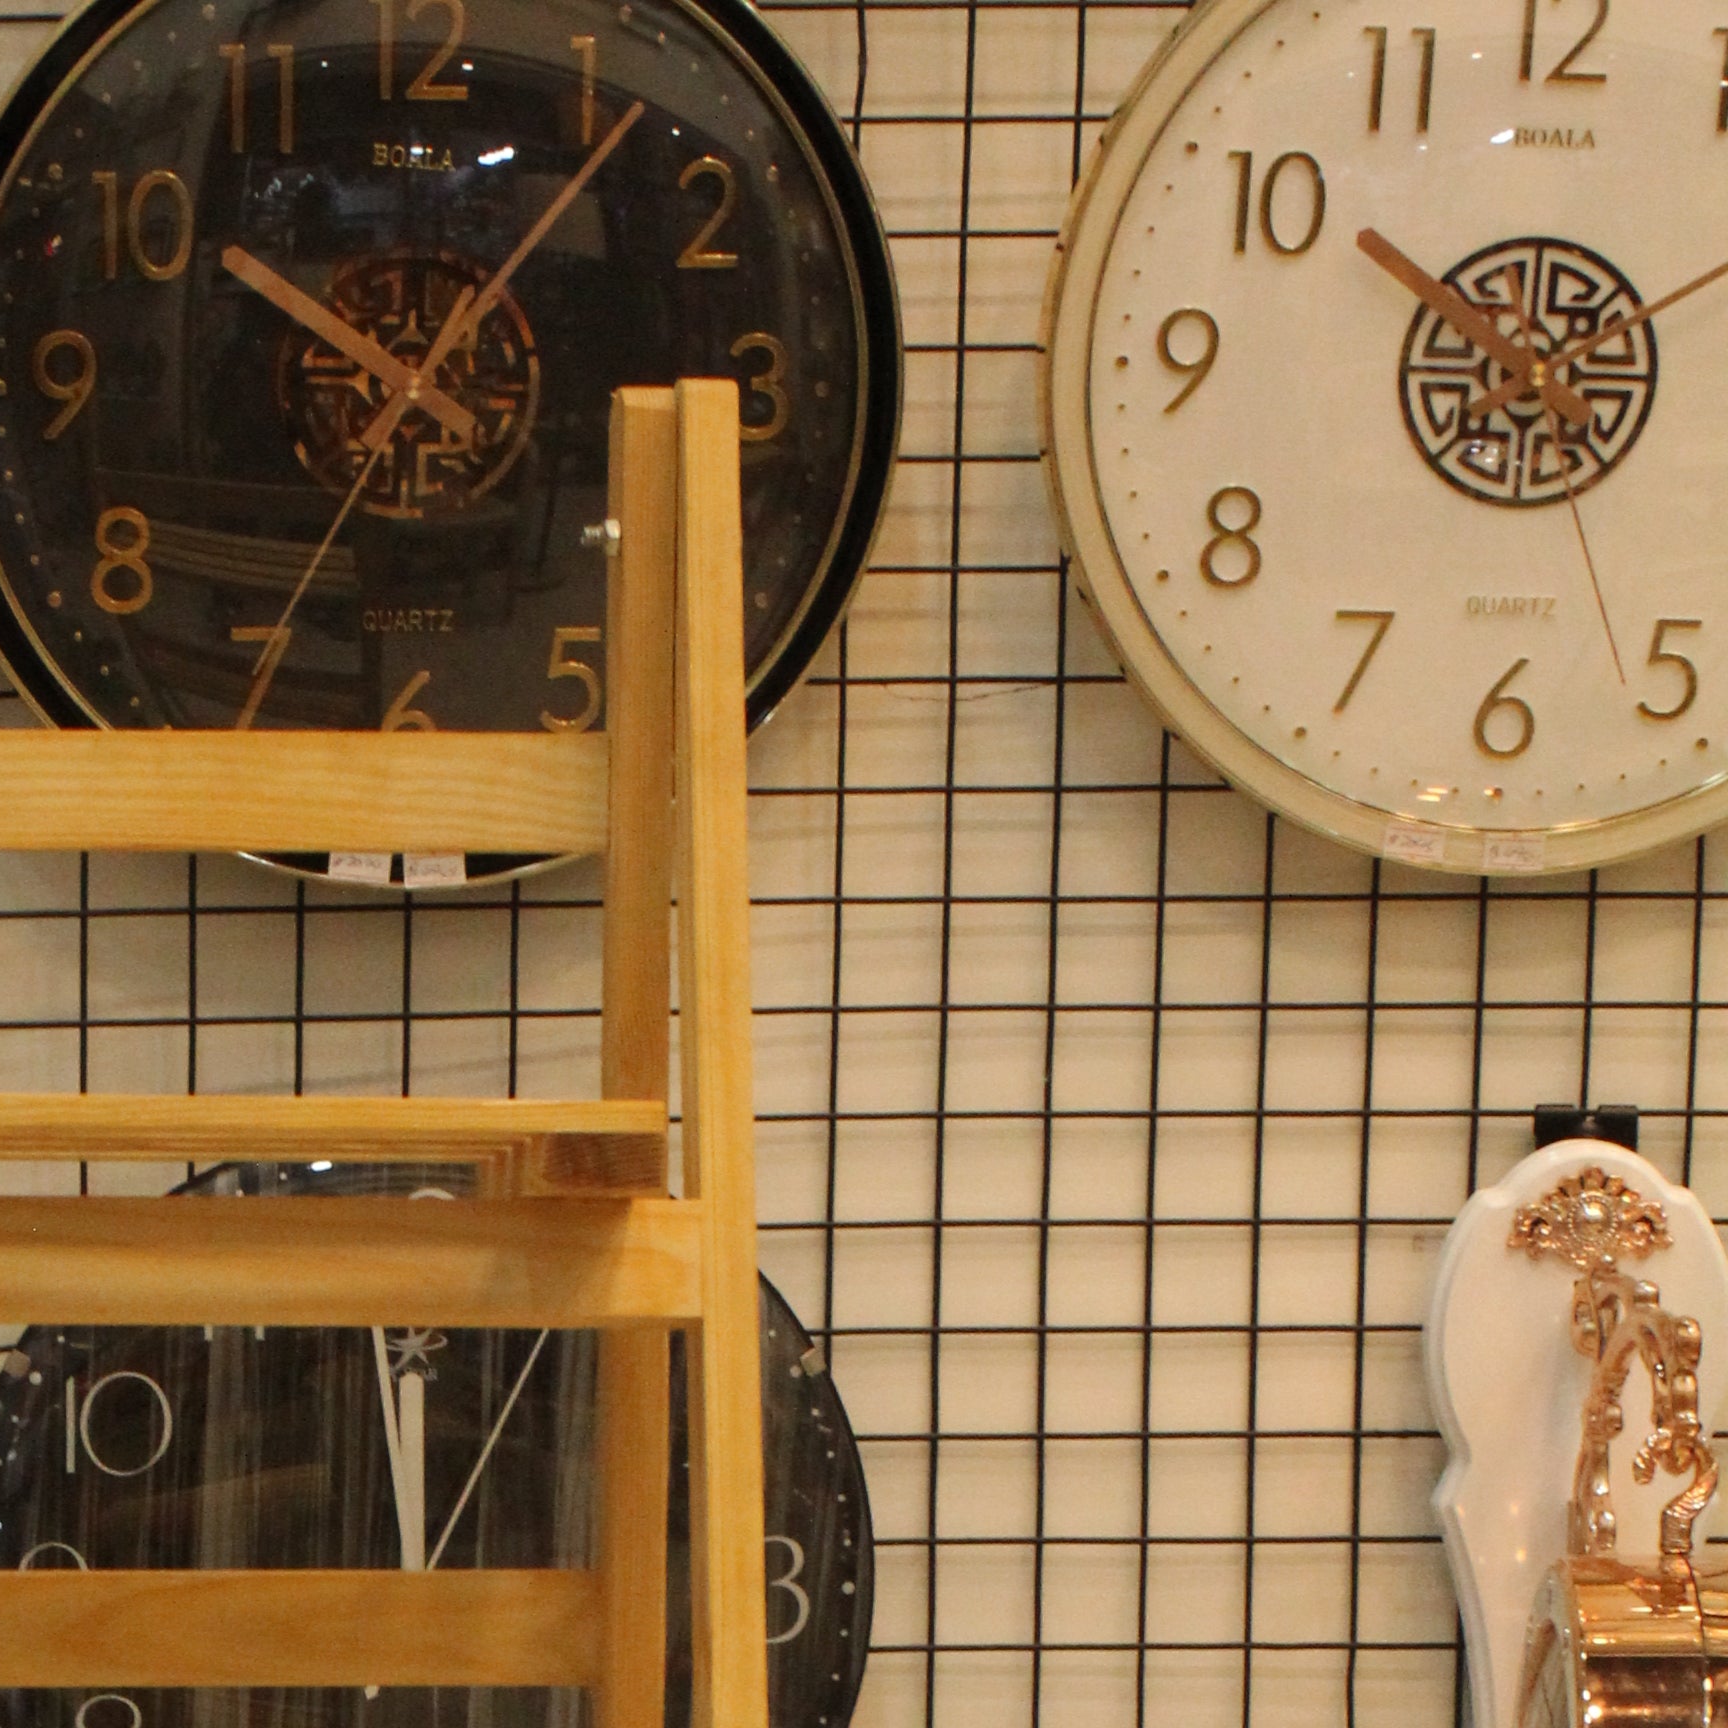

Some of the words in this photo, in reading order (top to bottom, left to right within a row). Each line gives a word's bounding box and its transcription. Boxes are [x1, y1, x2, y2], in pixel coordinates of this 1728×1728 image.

[379, 0, 469, 100] 12
[571, 35, 597, 146] 1
[1362, 26, 1436, 133] 11
[1518, 0, 1610, 83] 12
[219, 43, 295, 154] 11
[1515, 128, 1597, 149] BOALA
[90, 171, 194, 281] 10
[676, 158, 739, 269] 2
[1227, 150, 1327, 256] 10
[32, 330, 99, 441] 9
[729, 332, 791, 442] 3
[1155, 307, 1220, 414] 9
[89, 507, 153, 615] 8
[1199, 485, 1263, 589] 8
[363, 609, 455, 633] QUARTZ
[1466, 596, 1557, 619] QUARTZ
[230, 626, 292, 732] 7
[540, 626, 602, 733] 5
[1334, 610, 1396, 714] 7
[1472, 657, 1535, 759] 6
[1636, 619, 1703, 720] 5
[65, 1371, 173, 1476] 10
